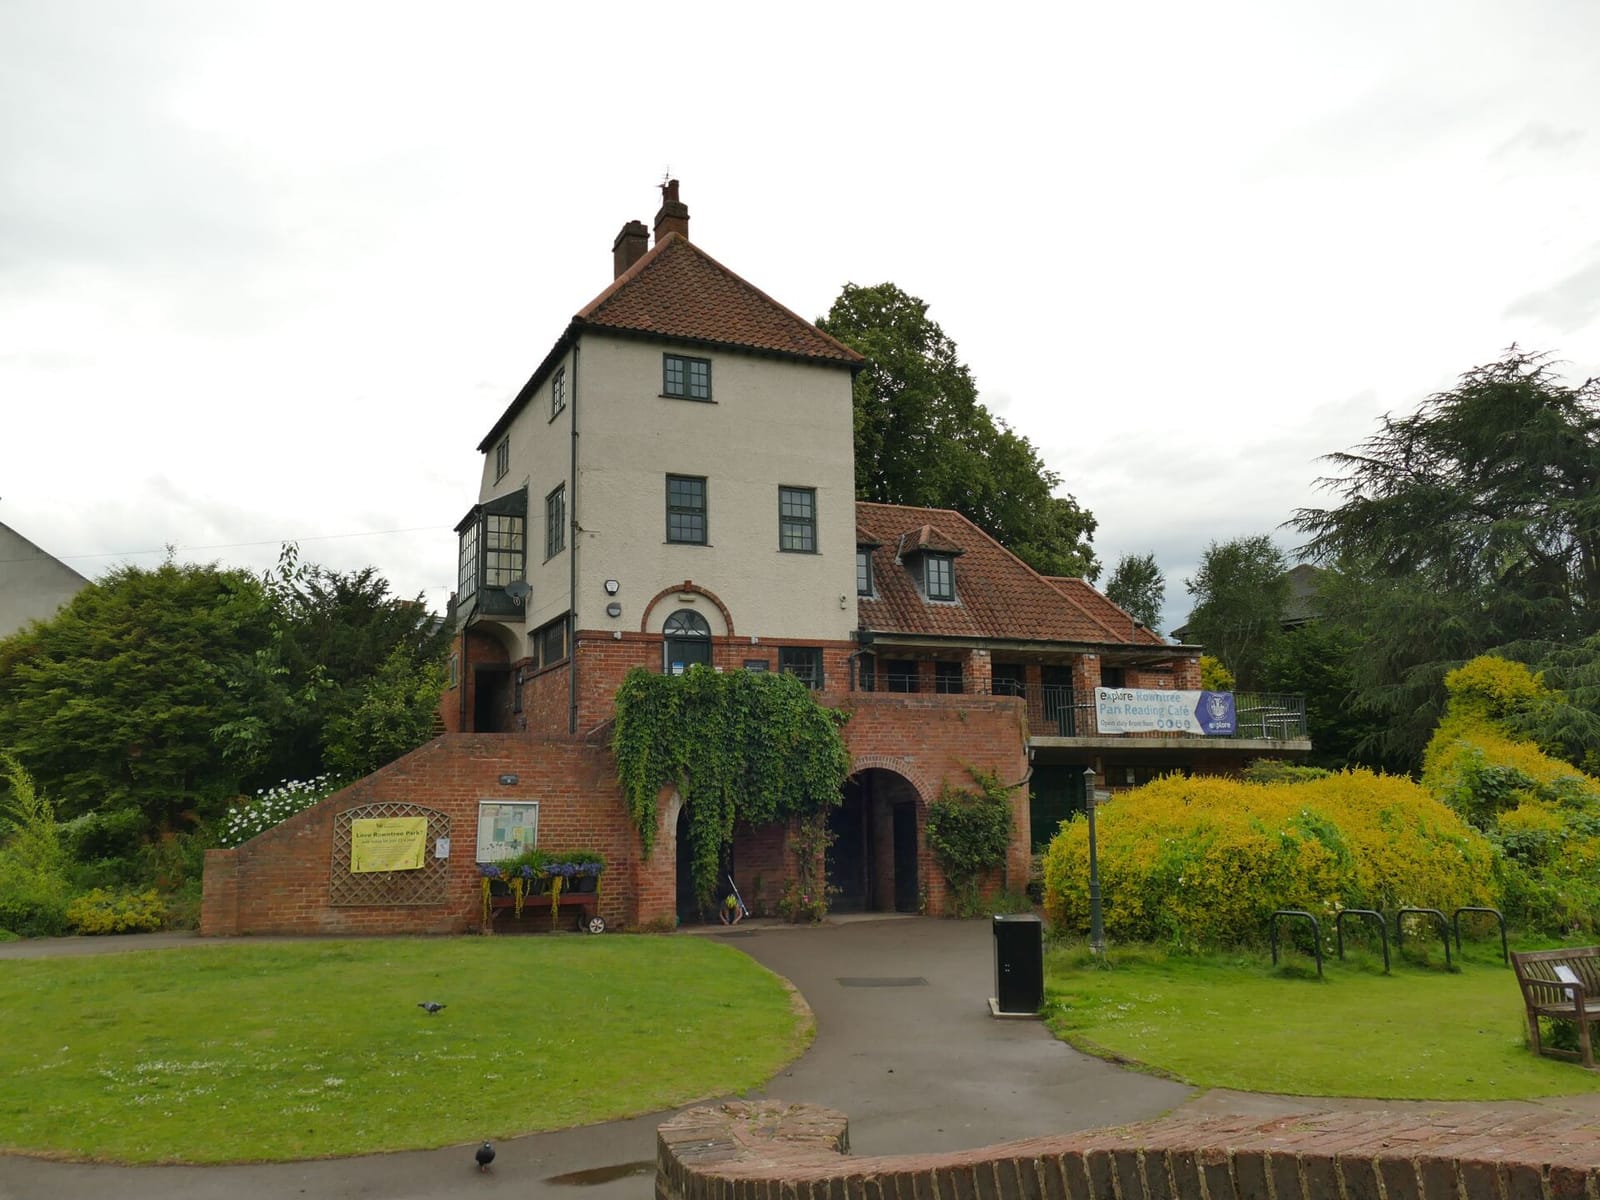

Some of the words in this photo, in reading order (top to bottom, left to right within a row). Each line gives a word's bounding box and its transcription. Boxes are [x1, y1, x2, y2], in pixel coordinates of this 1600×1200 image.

[1100, 690, 1133, 703] explore
[1136, 691, 1182, 702] Rowntree
[1125, 704, 1164, 718] Reading
[1168, 704, 1189, 716] Café
